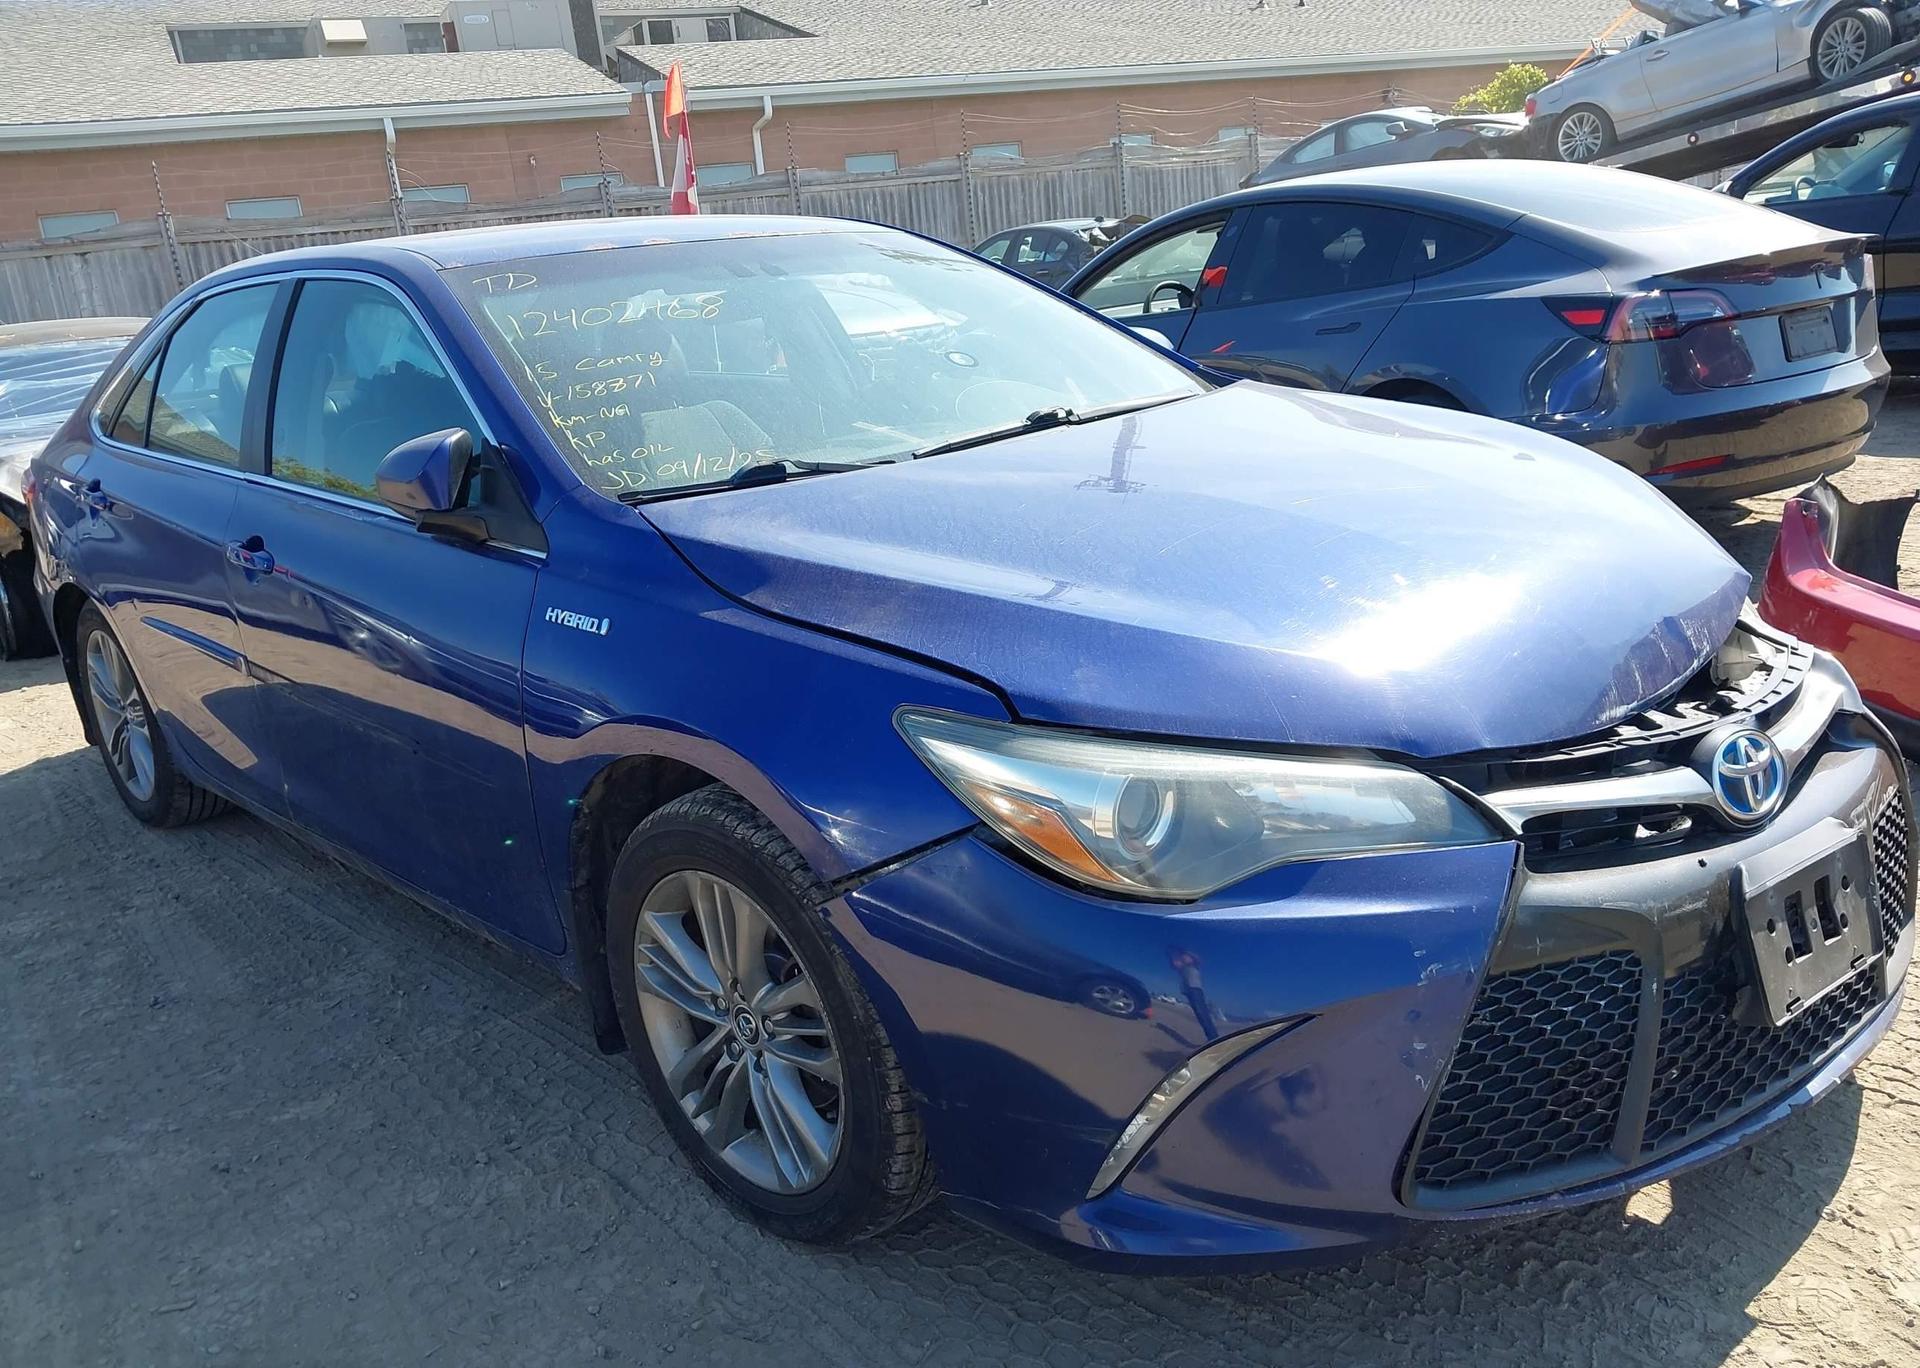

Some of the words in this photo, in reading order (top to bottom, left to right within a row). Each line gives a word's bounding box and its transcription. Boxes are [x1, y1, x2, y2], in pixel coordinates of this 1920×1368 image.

[507, 289, 728, 341] 12402468
[575, 351, 669, 371] Camry
[545, 606, 599, 633] HYBRID
